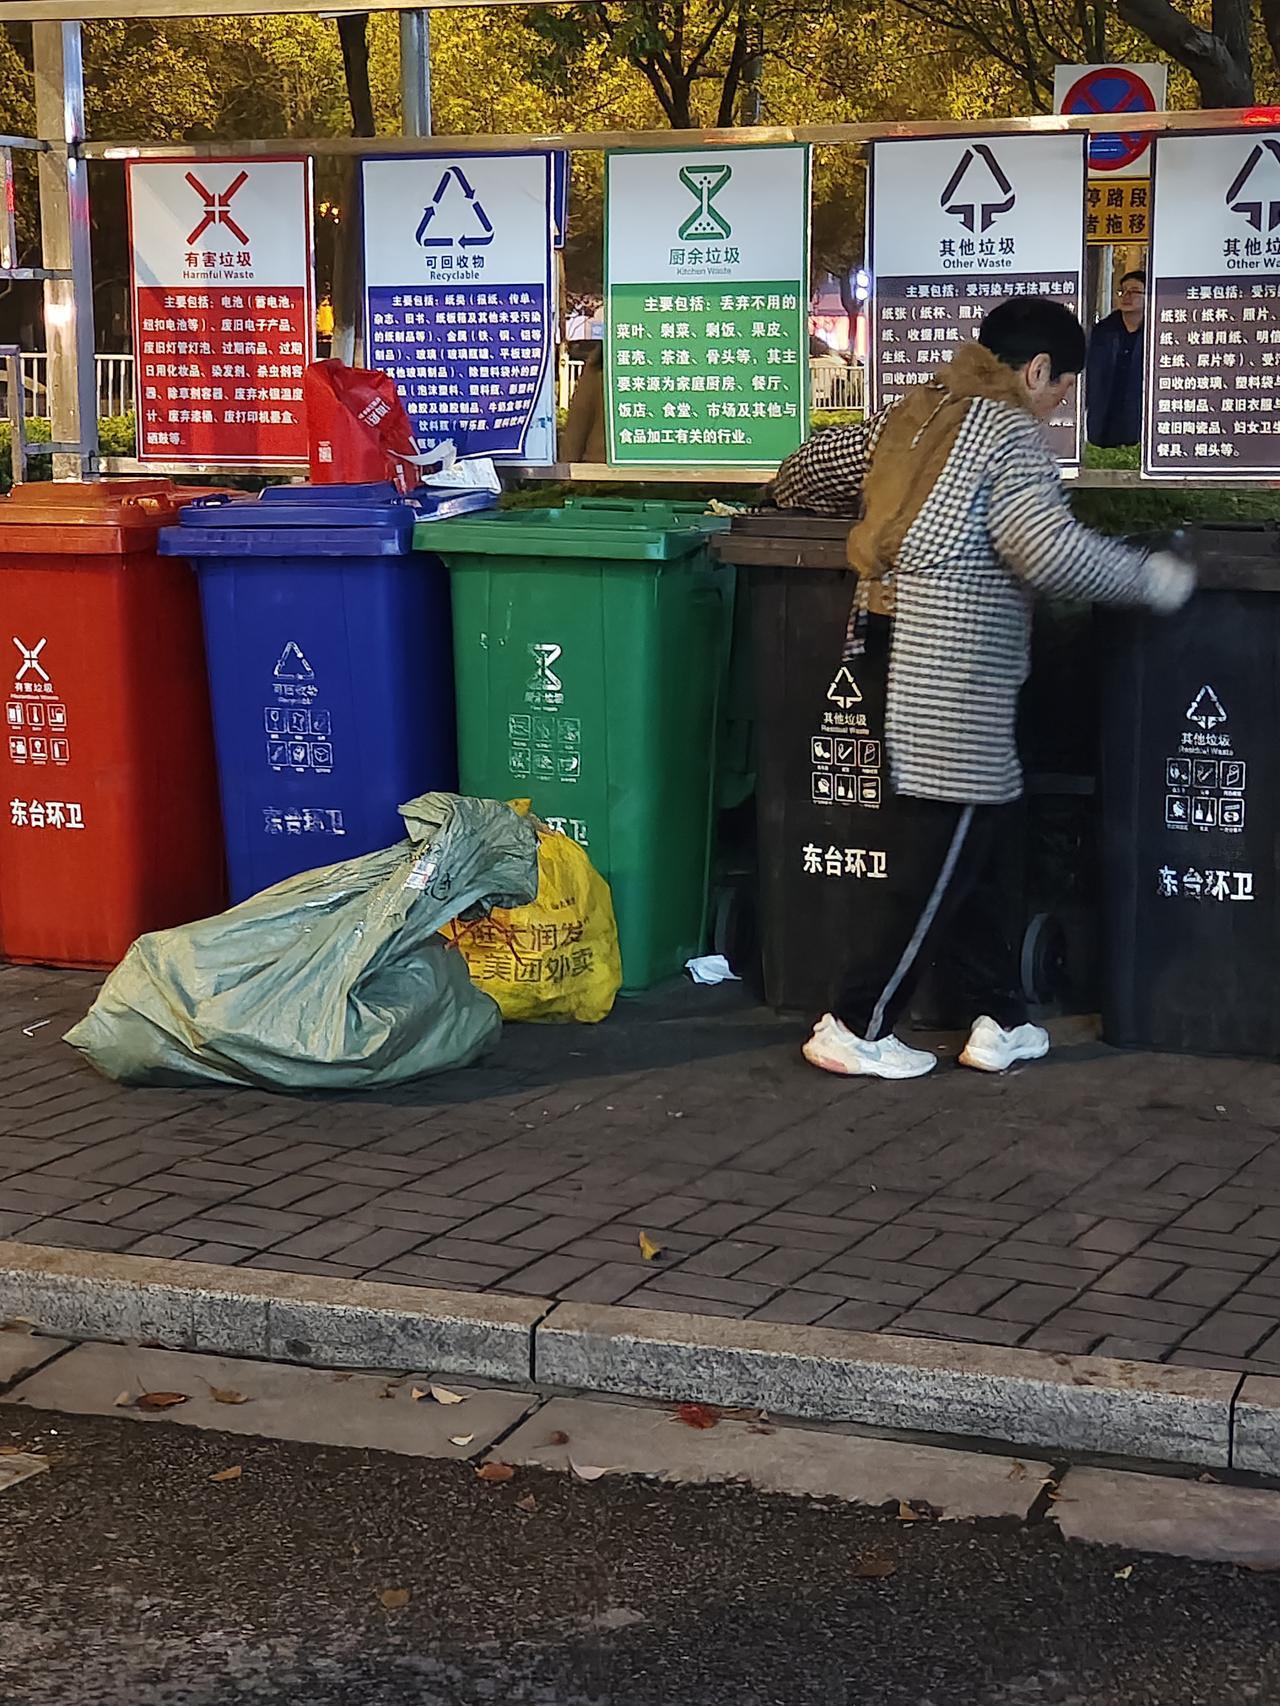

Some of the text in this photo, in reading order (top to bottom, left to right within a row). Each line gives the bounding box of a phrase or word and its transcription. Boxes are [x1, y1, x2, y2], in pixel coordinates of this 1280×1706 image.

[940, 238, 1016, 257] 其他垃圾
[185, 251, 252, 267] 有害垃圾
[425, 255, 485, 269] 可回收物
[669, 247, 740, 265] 厨余垃圾
[943, 258, 1012, 269] Other Waste
[1227, 258, 1260, 269] Other
[183, 270, 254, 279] Harmful Waste
[430, 270, 480, 281] Recyclable
[676, 267, 706, 276] Kitchen
[1187, 284, 1280, 300] 主要包括：受污
[823, 712, 867, 726] 其他垃圾
[1181, 733, 1231, 747] 其他垃圾
[10, 798, 85, 829] 东台环卫
[802, 843, 888, 878] 东台环卫
[1157, 865, 1254, 901] 东台环卫
